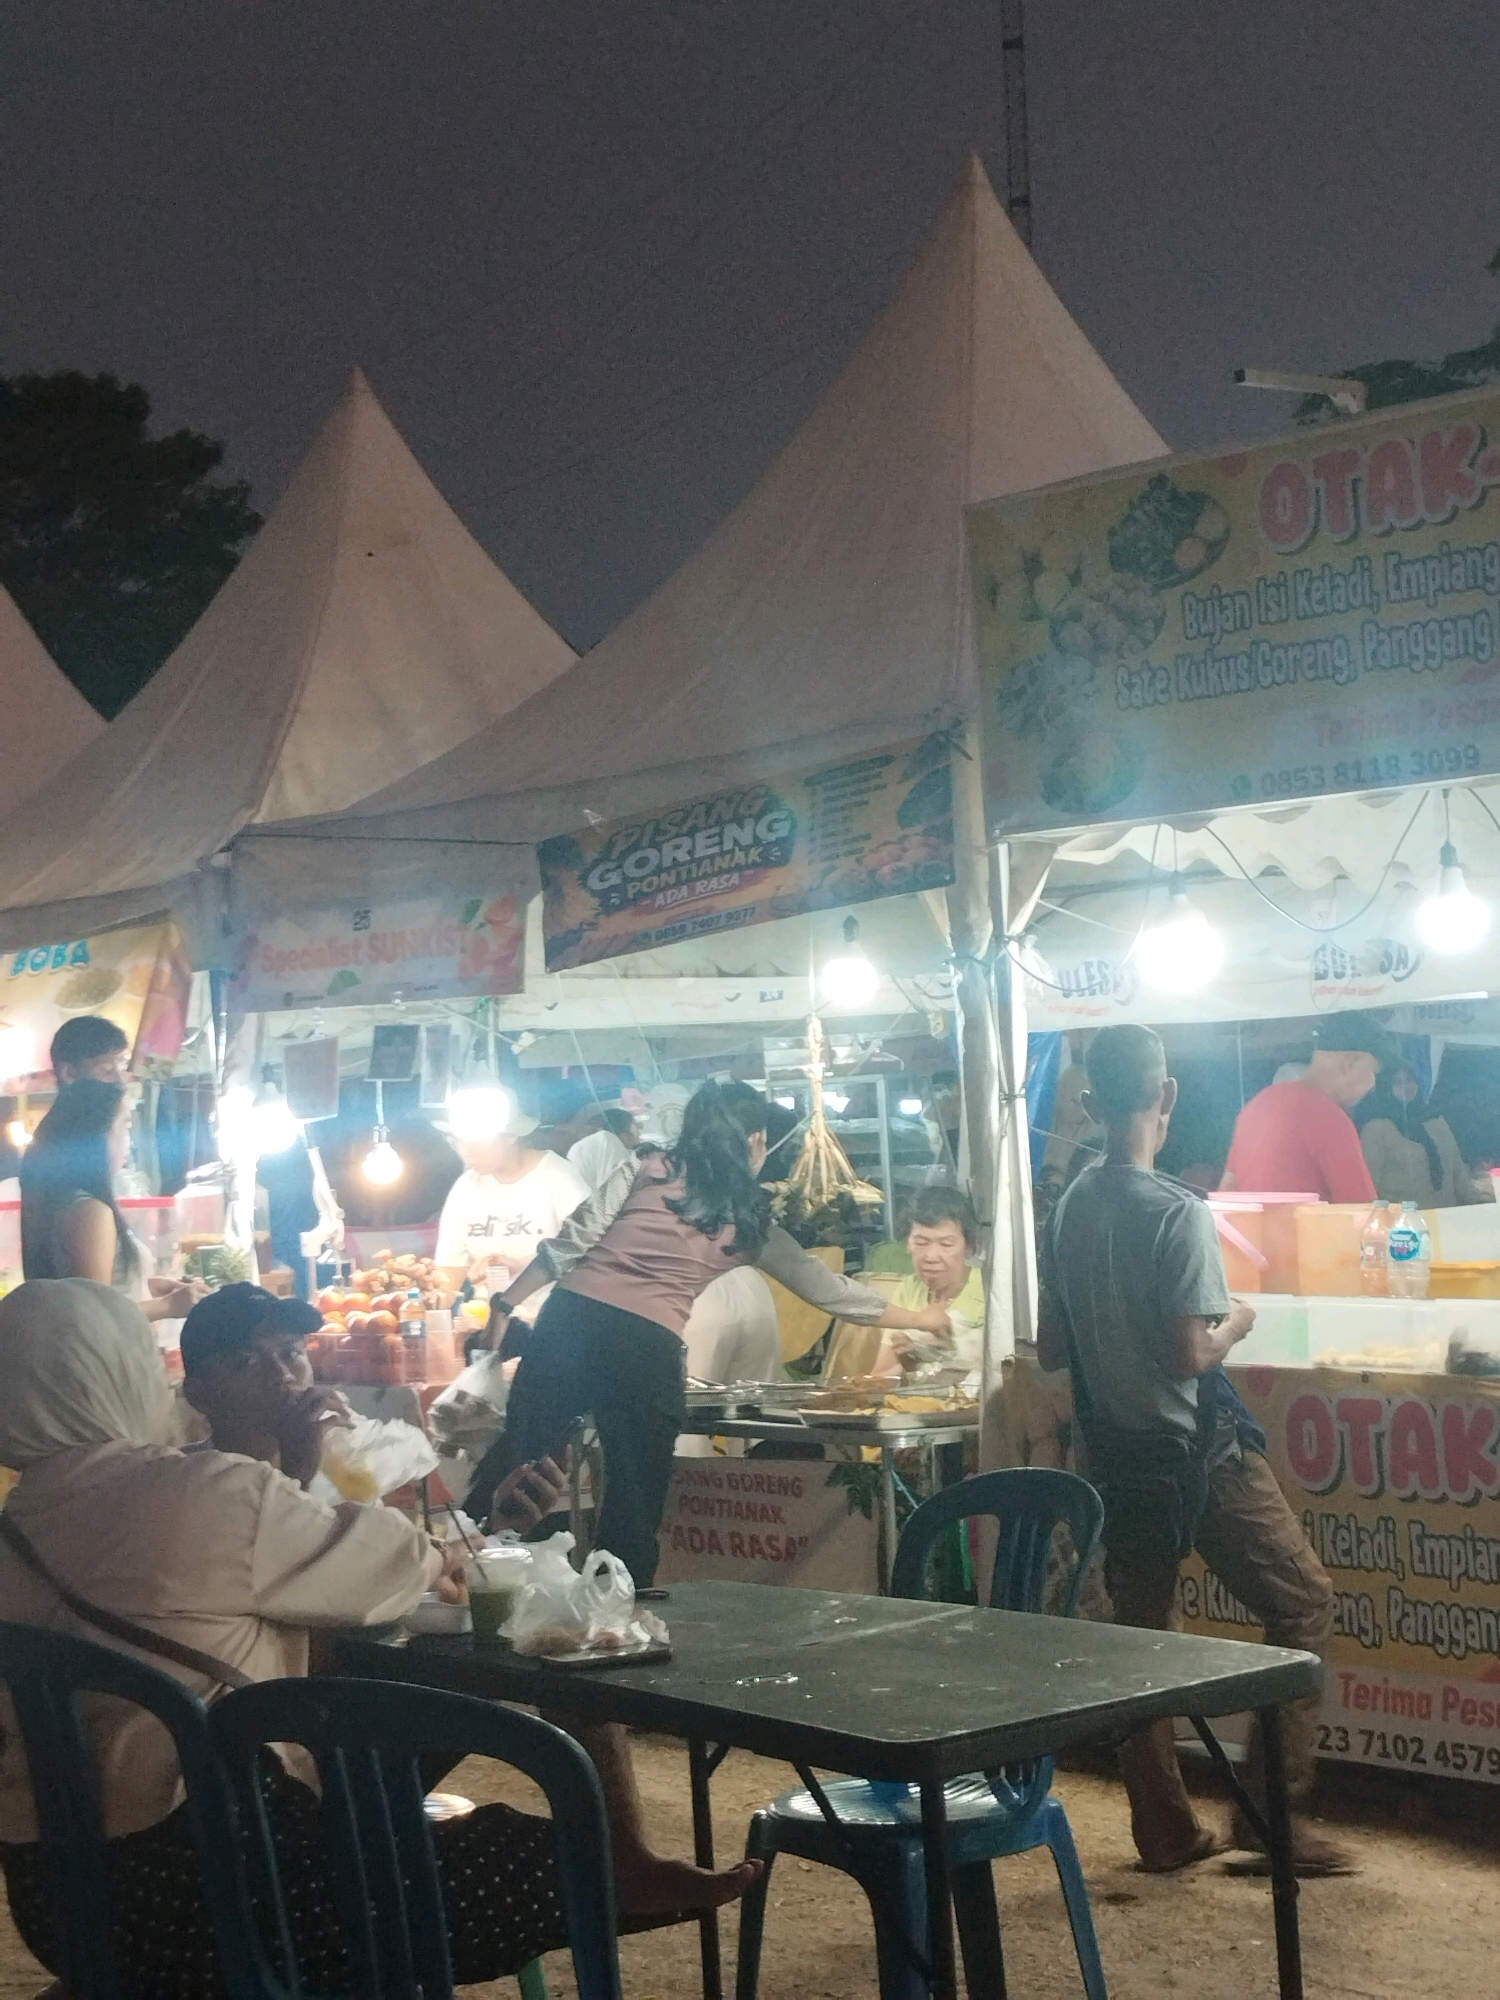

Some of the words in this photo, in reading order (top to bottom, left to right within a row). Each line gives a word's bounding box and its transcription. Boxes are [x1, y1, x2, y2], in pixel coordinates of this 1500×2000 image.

[1257, 570, 1289, 625] Isi
[1294, 554, 1379, 614] Keladi,
[1115, 664, 1169, 710] Sate
[1362, 609, 1493, 671] Panggang
[1260, 765, 1327, 796] 0853
[1410, 743, 1481, 775] 3099
[587, 810, 792, 891] GORENG
[611, 786, 770, 859] PISANG
[626, 847, 764, 899] PONTIANAK
[654, 887, 688, 908] ADA
[694, 872, 740, 894] RASA
[9, 939, 90, 978] BOBA
[1285, 1391, 1500, 1506] OTAK
[727, 1472, 803, 1499] GORENG
[1320, 1512, 1405, 1581] Keladi,
[1387, 1585, 1500, 1660] Panggan
[1338, 1672, 1432, 1720] Terima
[1441, 1684, 1500, 1728] Pes
[1316, 1723, 1351, 1752] 23
[1358, 1728, 1427, 1764] 7102
[1434, 1740, 1500, 1776] 4579
